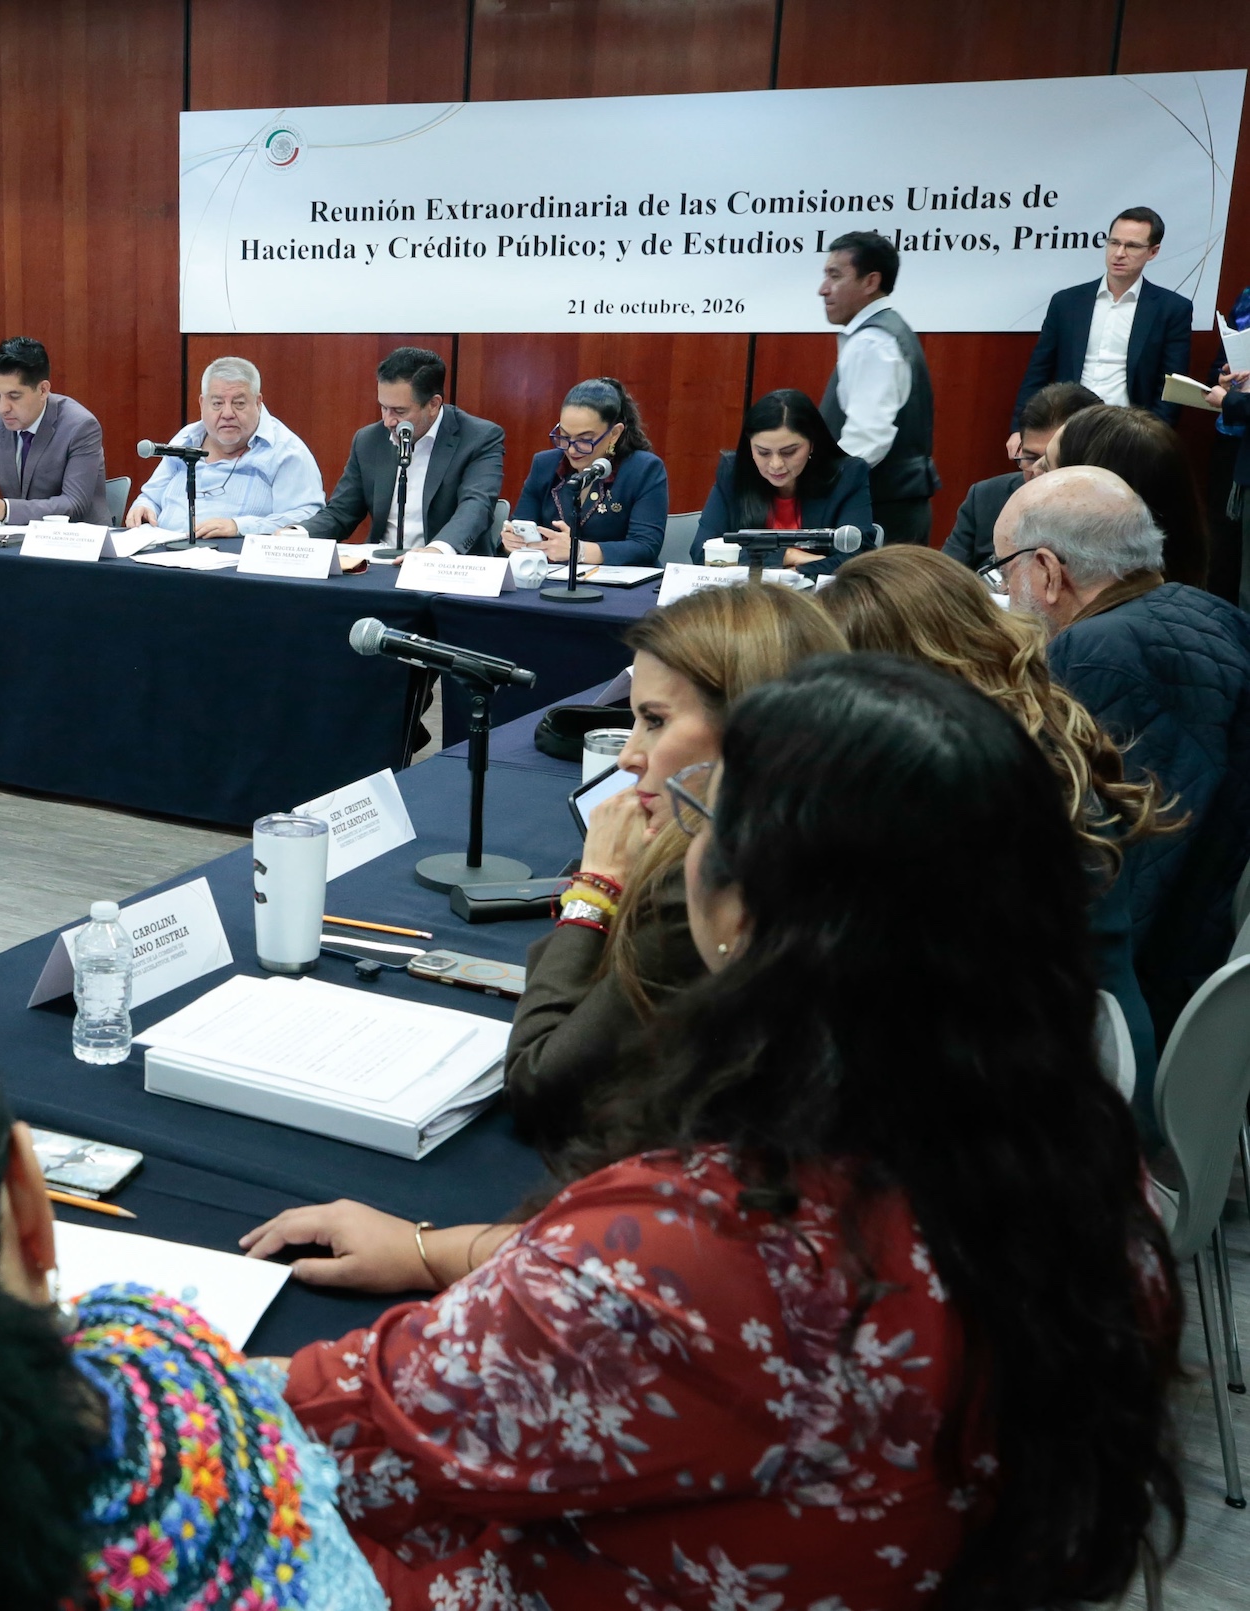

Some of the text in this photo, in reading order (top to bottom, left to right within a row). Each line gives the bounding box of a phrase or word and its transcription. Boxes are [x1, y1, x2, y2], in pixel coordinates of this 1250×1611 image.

[309, 184, 1059, 223] Reunión Extraordinaria de las Comisiones Unidas de
[240, 225, 1108, 266] Hacienda y Crédito Público; y de Estudios Llativos, Prime
[567, 298, 745, 316] 21 de octubre, 2026
[330, 797, 372, 822] SEN. CRISTINA
[347, 808, 378, 829] SANDOVAL
[132, 914, 178, 941] CAROLINA
[155, 926, 190, 949] AUSTRIA
